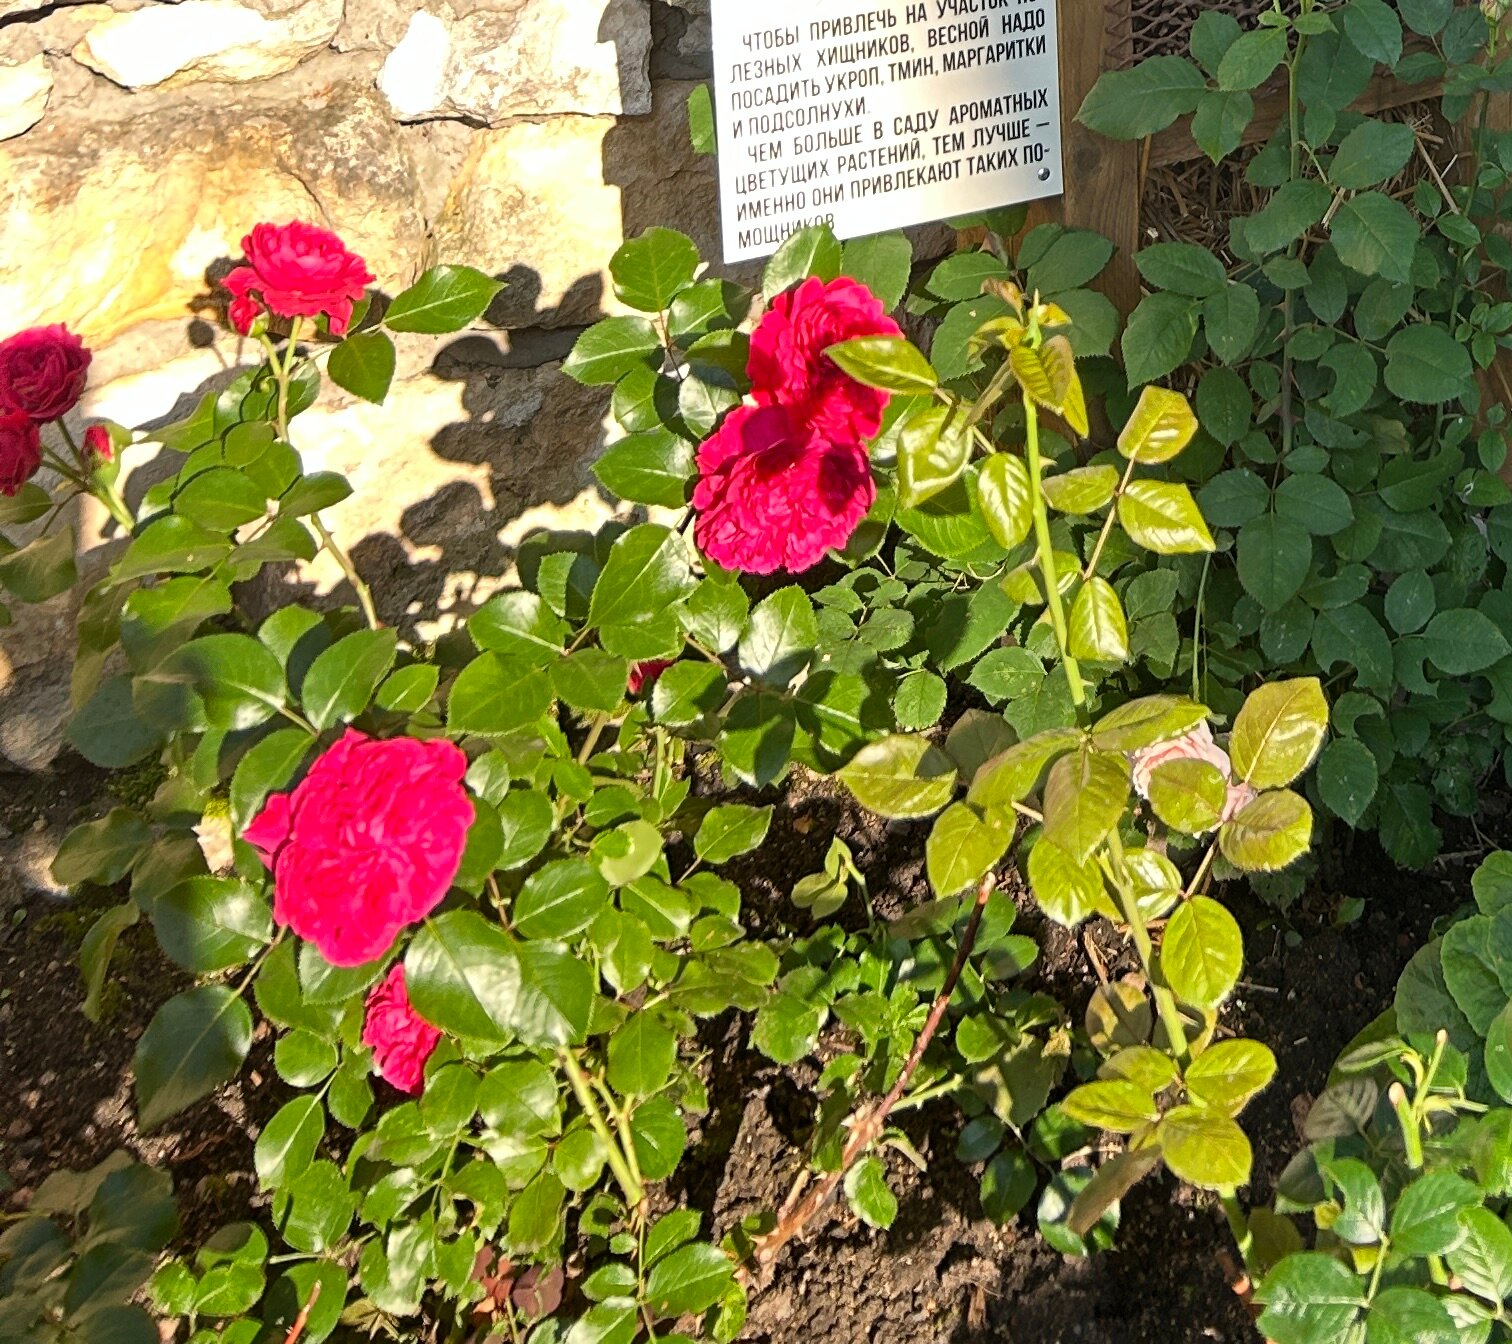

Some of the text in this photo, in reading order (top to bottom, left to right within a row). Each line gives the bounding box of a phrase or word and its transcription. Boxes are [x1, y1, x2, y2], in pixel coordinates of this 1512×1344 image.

[730, 9, 1045, 84] ЛЕЗНЫХ ХИЩНИКОВ, ВЕСНОЙ НАДО
[743, 26, 799, 52] ЧТОБЫ
[810, 9, 897, 41] ПРИВЛЕЧЬ
[906, 3, 928, 25] НА
[732, 35, 1046, 110] ПОСАДИТЬ УКРОП, ТМИН, МАРГАРИТКИ
[733, 121, 742, 139] И
[736, 118, 1030, 196] ЦВЕТУЩИХ РАСТЕНИЙ, ТЕМ ЛУЧШЕ
[748, 88, 1048, 164] ЧЕМ БОЛЬШЕ В САДУ АРОМАТНЫХ
[737, 143, 1050, 222] ИМЕННО ОНИ ПРИВЛЕКАЮТ ТАКИХ ПО-
